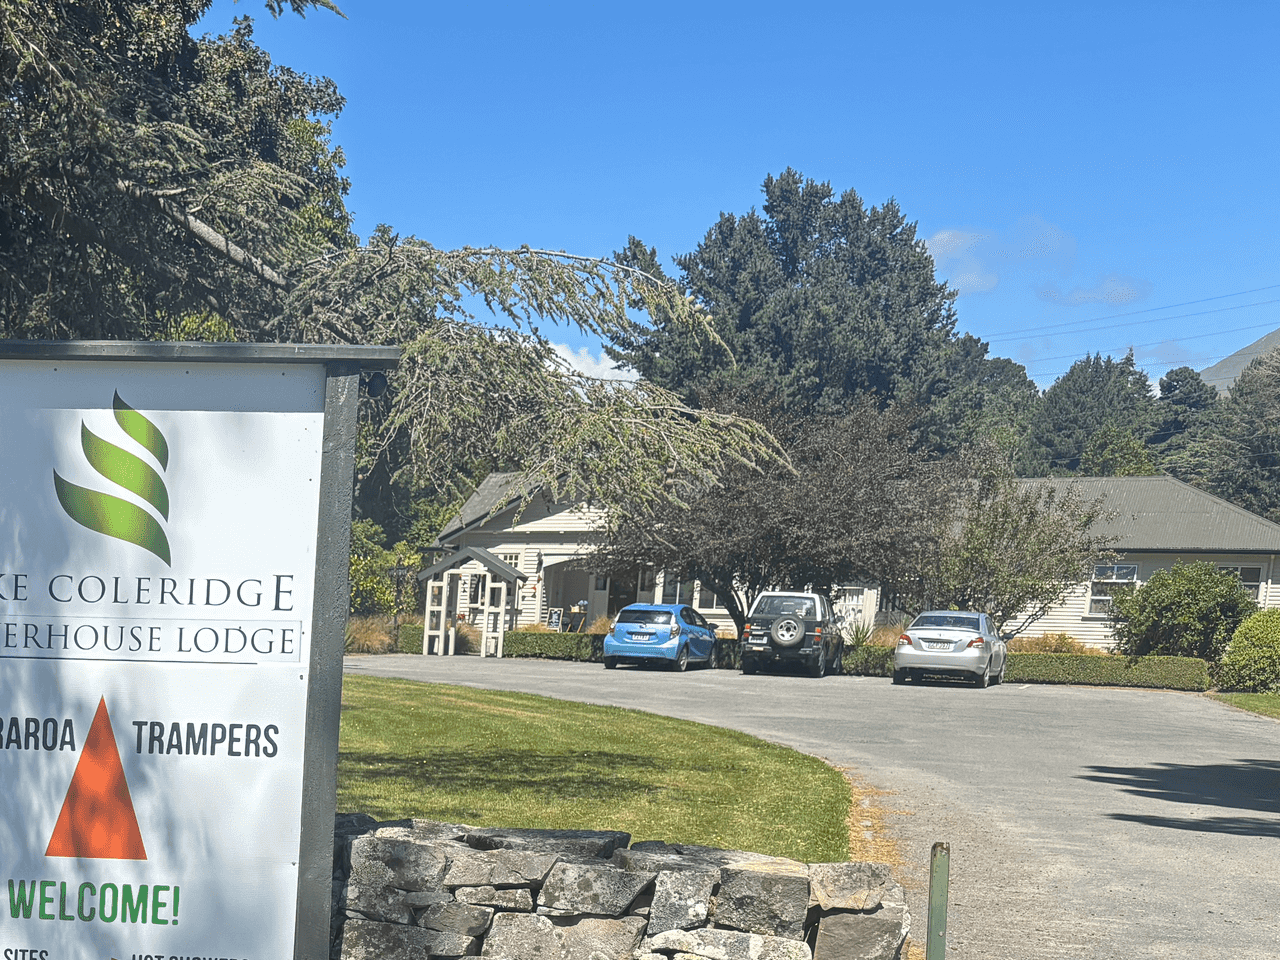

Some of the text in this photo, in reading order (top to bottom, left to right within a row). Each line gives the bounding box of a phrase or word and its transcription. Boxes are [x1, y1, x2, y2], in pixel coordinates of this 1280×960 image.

[48, 573, 294, 612] COLERIDGE
[176, 626, 294, 655] LODGE
[132, 720, 280, 758] TRAMPERS
[8, 878, 181, 926] WELCOME!
